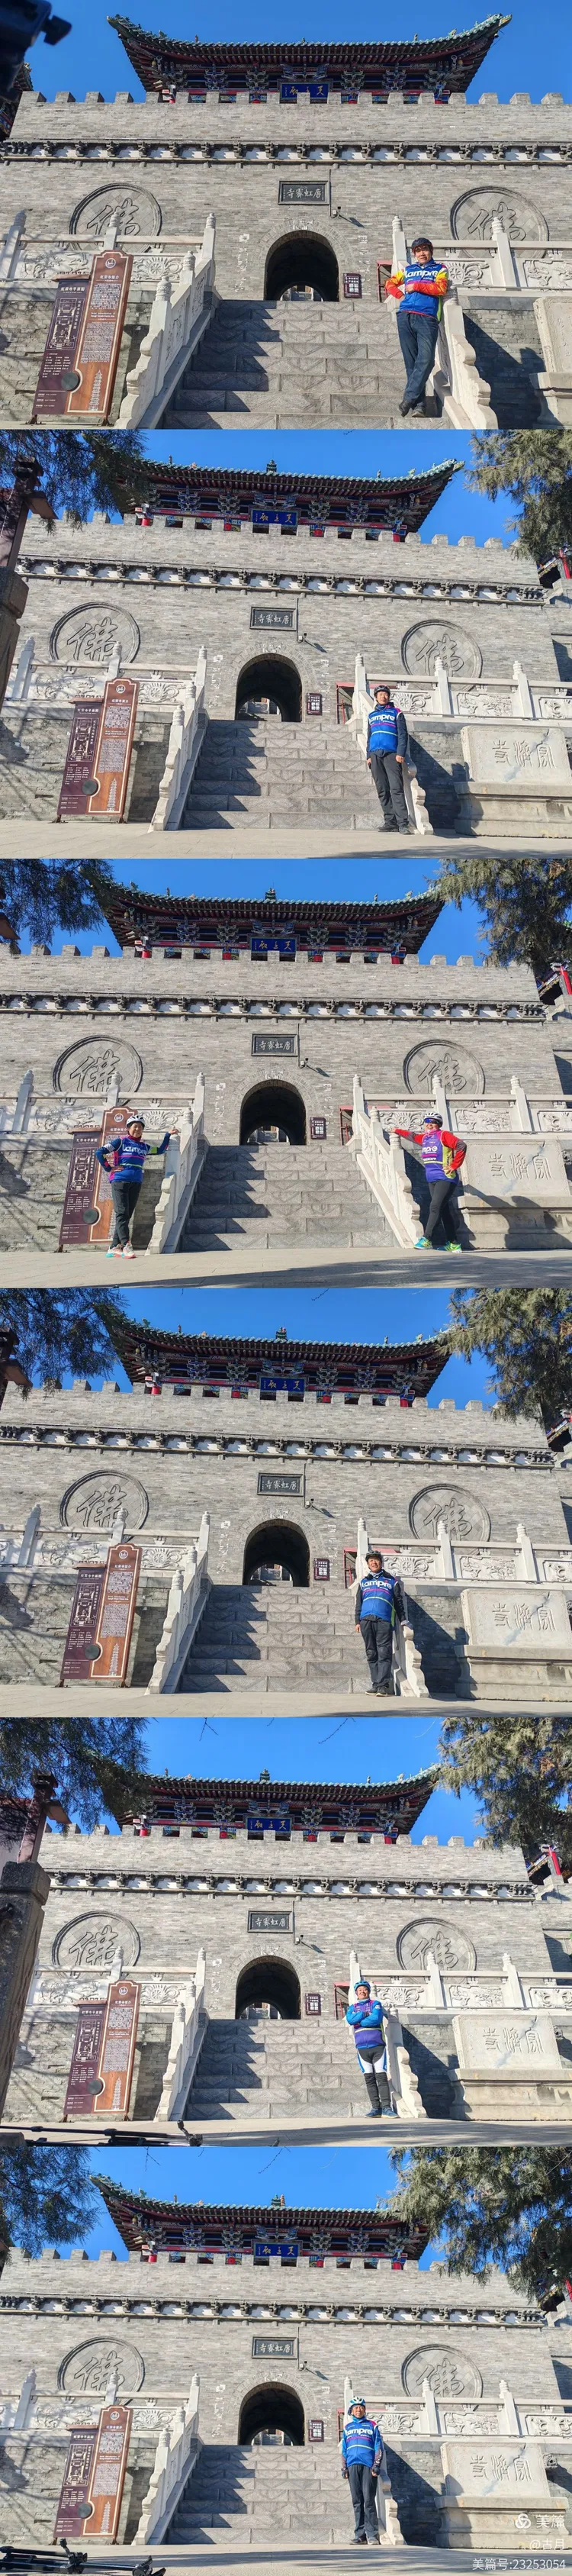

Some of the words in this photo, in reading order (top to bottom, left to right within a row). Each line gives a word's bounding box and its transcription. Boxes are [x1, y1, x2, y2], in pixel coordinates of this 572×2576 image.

[87, 197, 140, 236] 佛
[468, 202, 526, 241] 佛
[67, 617, 118, 661] 佛
[416, 634, 464, 676] 佛
[69, 1049, 122, 1092] 佛
[418, 1053, 467, 1094] 佛
[77, 1484, 128, 1527] 佛
[423, 1498, 472, 1541] 佛
[69, 1925, 119, 1967] 佛
[411, 1931, 458, 1970] 佛
[75, 2351, 125, 2391] 佛
[416, 2358, 464, 2397] 佛
